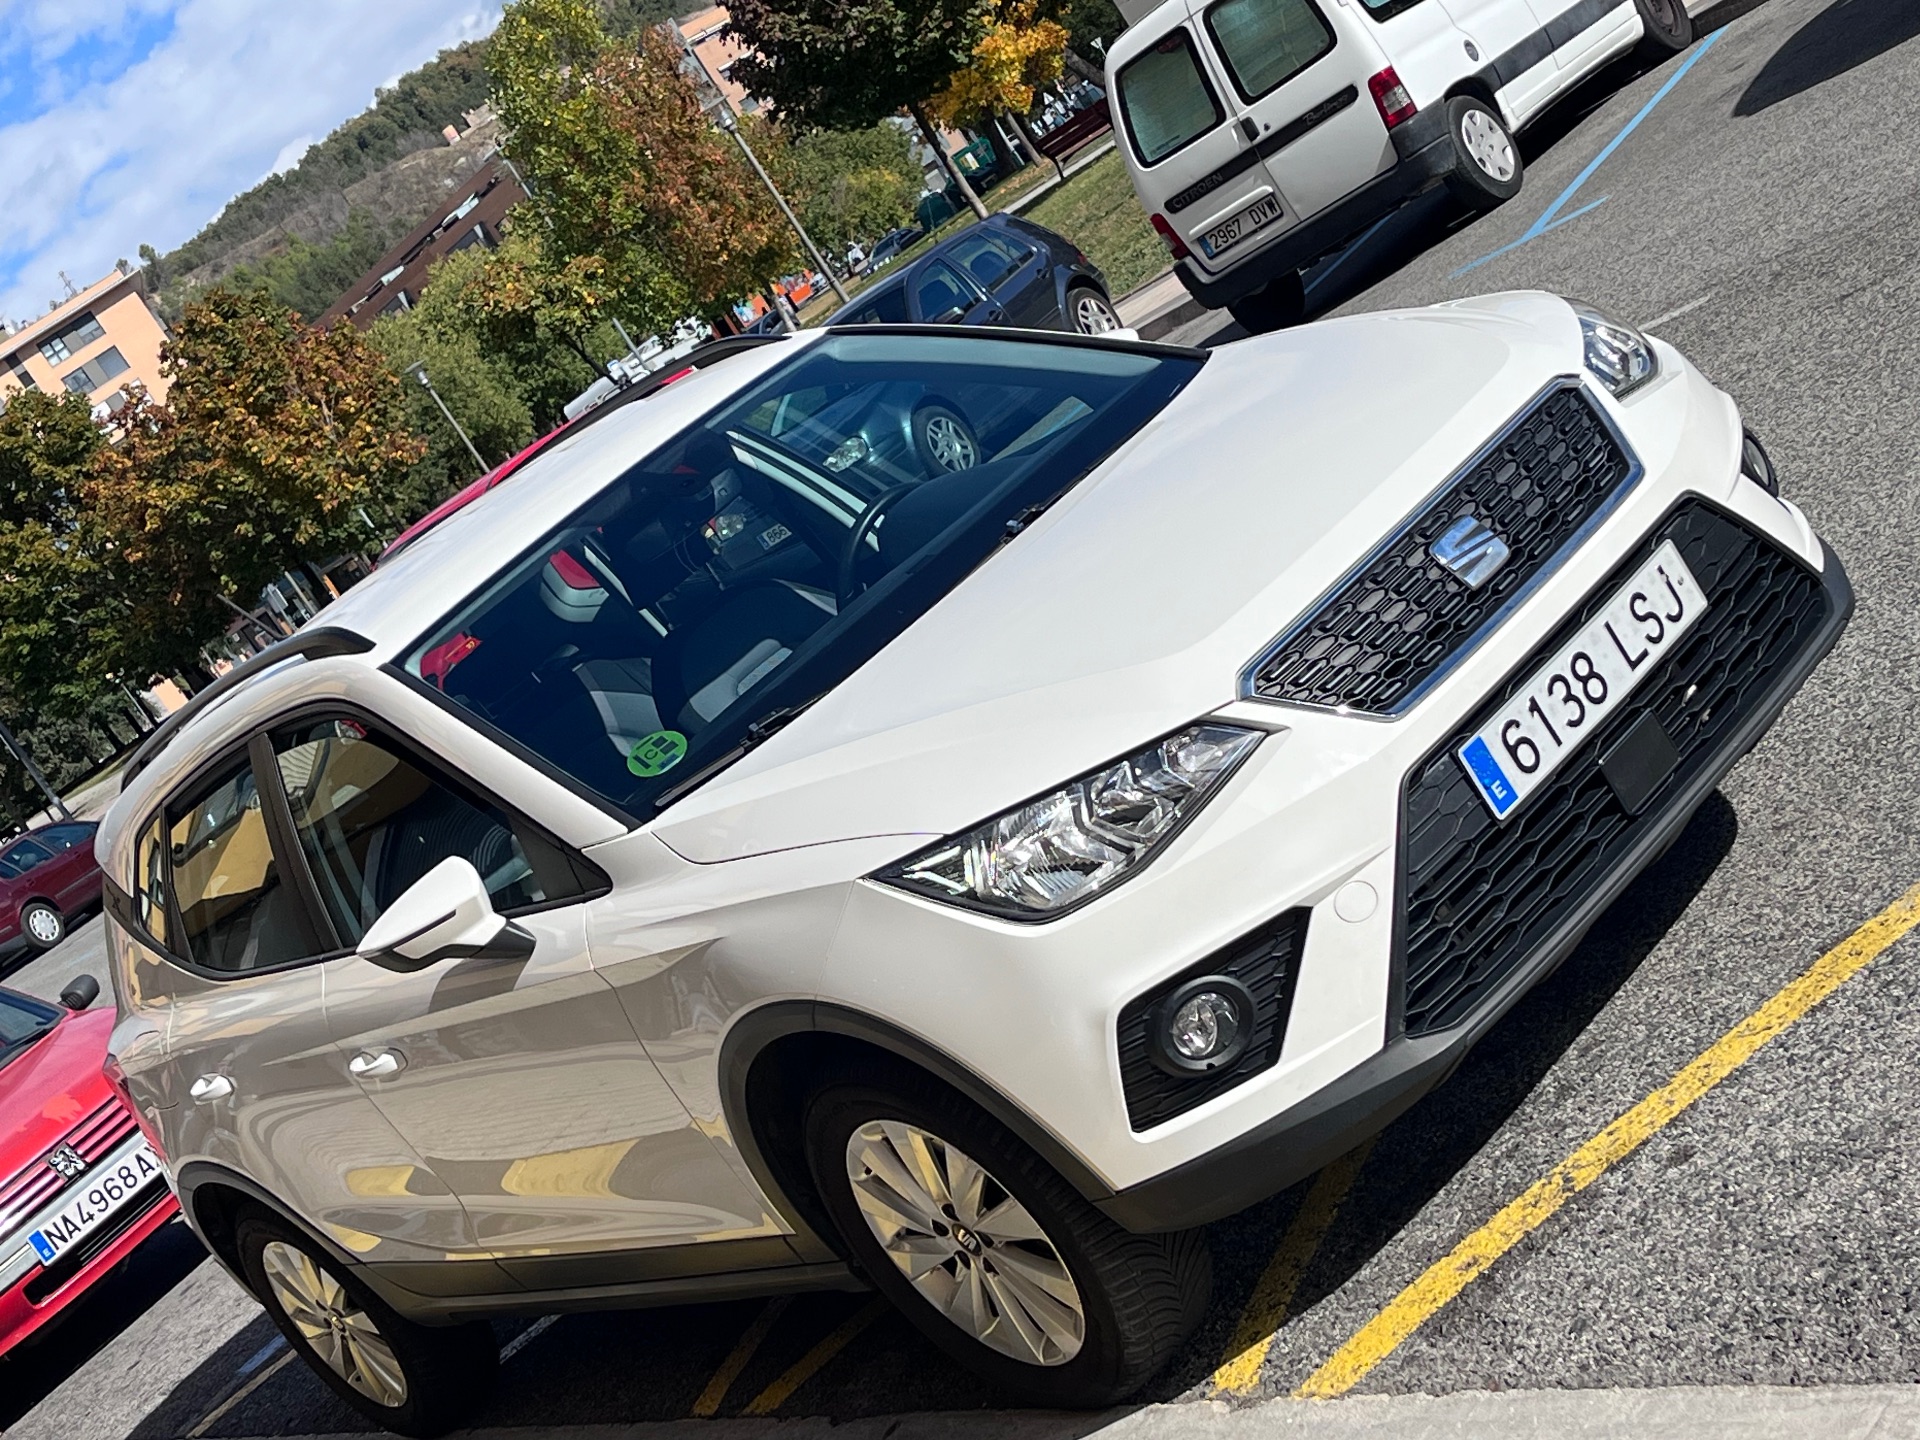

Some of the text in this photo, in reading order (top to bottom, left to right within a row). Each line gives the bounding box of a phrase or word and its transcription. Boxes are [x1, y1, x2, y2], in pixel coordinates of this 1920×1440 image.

[1209, 198, 1278, 250] 2967 DVW
[1501, 565, 1684, 774] 6138 LSJ
[1490, 780, 1508, 800] E
